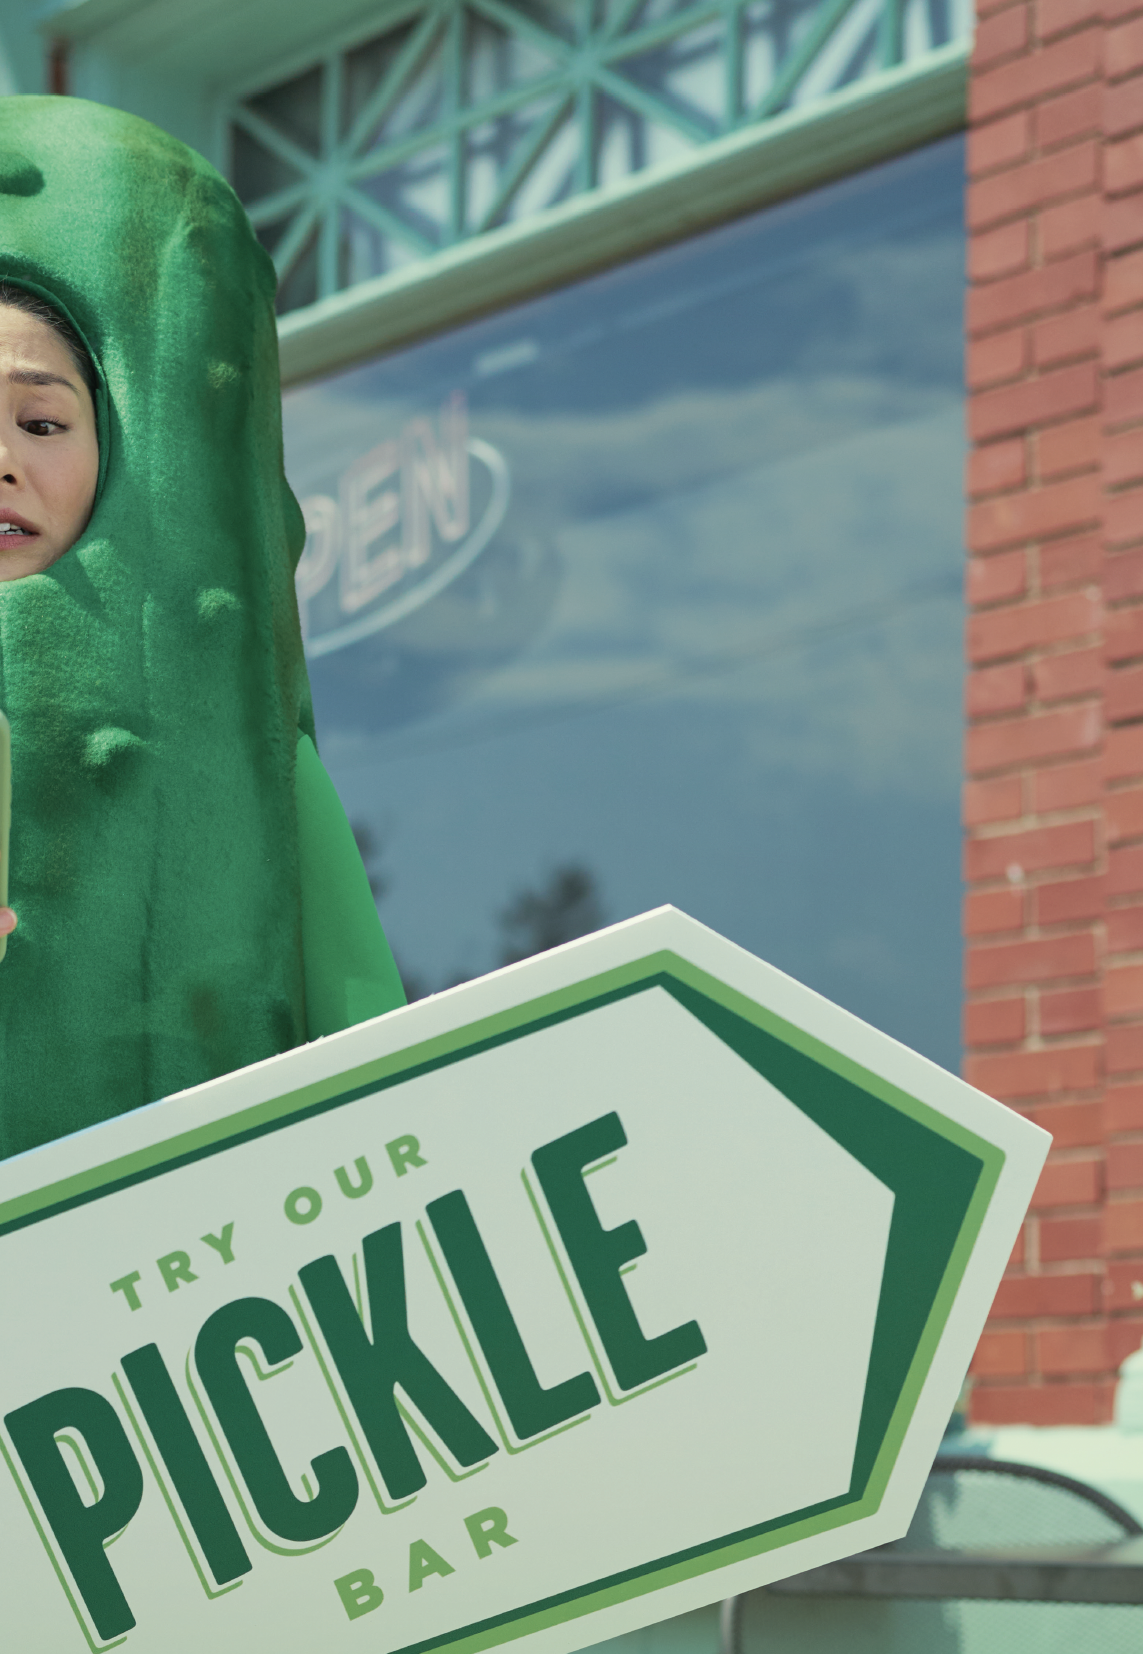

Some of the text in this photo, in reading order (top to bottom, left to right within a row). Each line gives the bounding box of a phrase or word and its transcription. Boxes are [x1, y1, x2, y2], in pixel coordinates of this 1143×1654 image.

[295, 388, 472, 645] PEN
[110, 1134, 428, 1312] TRY OUR
[333, 1506, 519, 1622] BAR
